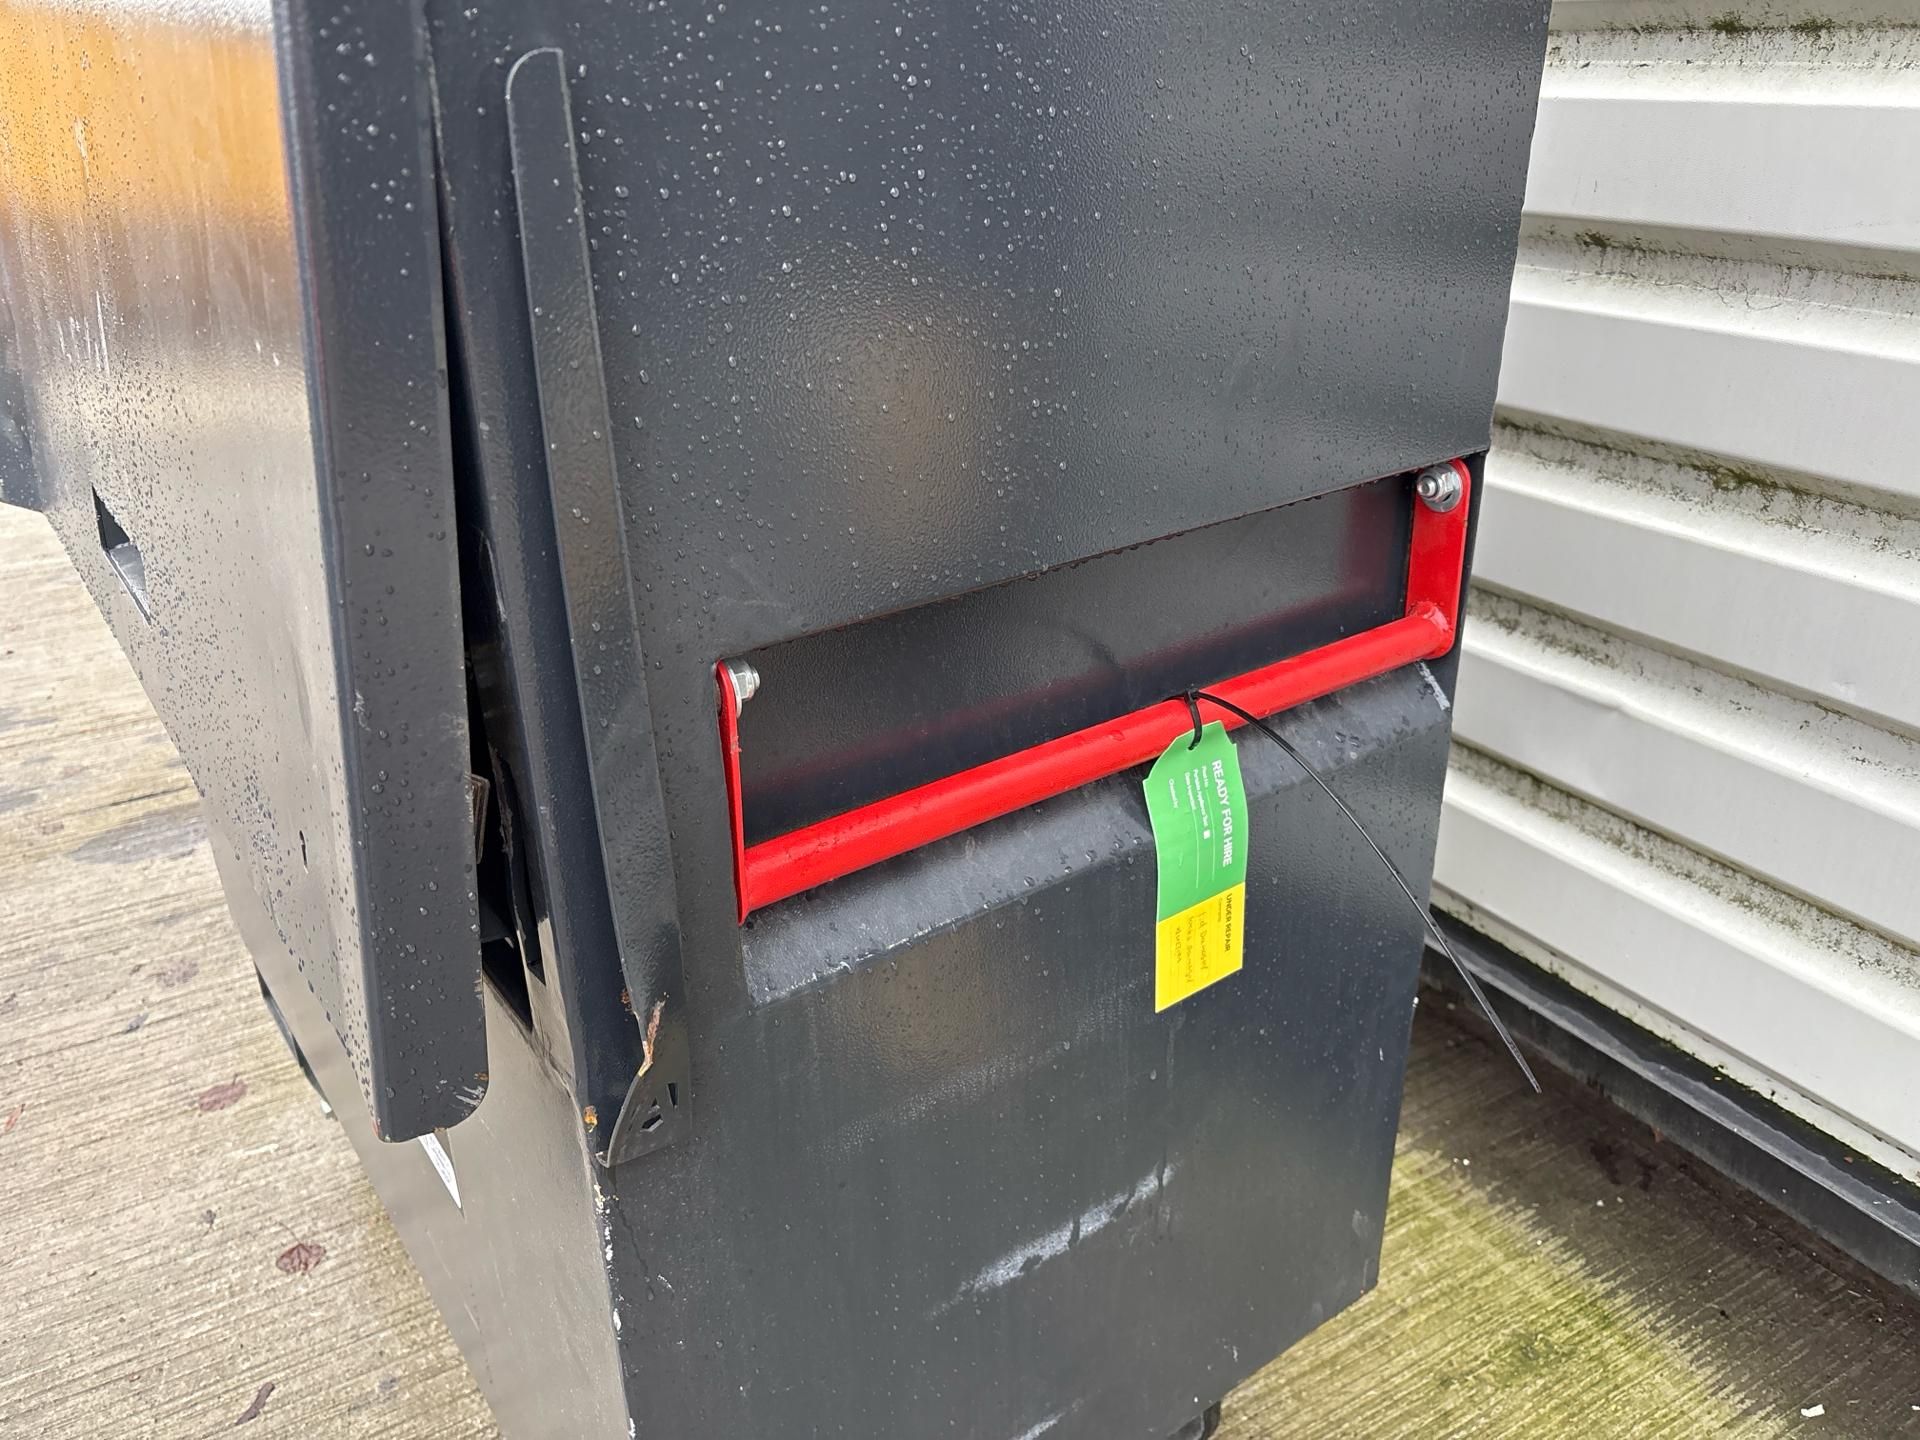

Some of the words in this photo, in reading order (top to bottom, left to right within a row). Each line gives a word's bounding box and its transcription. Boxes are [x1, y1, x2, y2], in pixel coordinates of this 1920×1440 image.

[1212, 760, 1229, 806] READY
[1221, 808, 1232, 837] FOR
[1222, 836, 1232, 867] HIRE
[1225, 893, 1233, 923] UNDER
[1224, 923, 1232, 953] REPAIR
